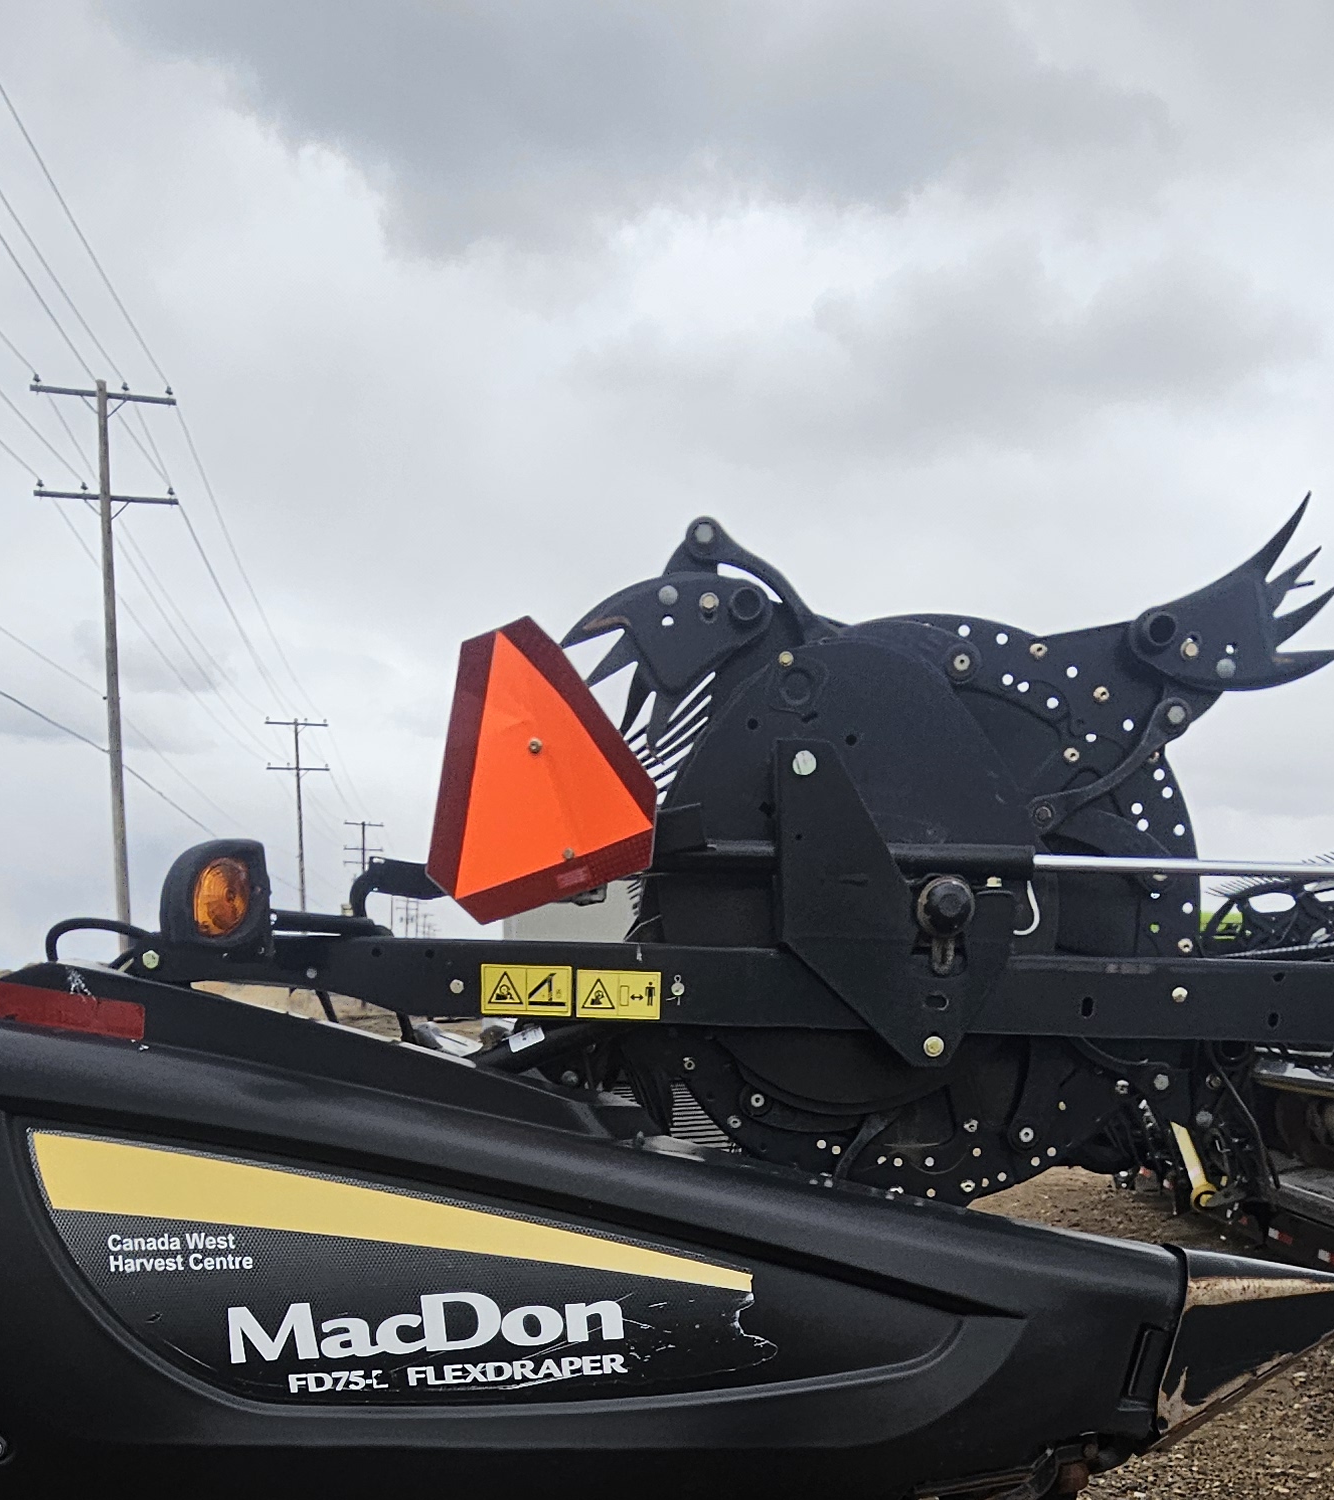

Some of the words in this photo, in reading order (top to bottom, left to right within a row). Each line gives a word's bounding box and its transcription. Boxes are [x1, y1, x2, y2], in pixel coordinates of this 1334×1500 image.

[107, 1233, 181, 1251] Canada
[185, 1233, 236, 1249] West
[109, 1254, 184, 1273] Harvest
[189, 1253, 253, 1270] Centre
[227, 1292, 624, 1364] MacDon
[407, 1353, 628, 1387] FLEXDRAPER
